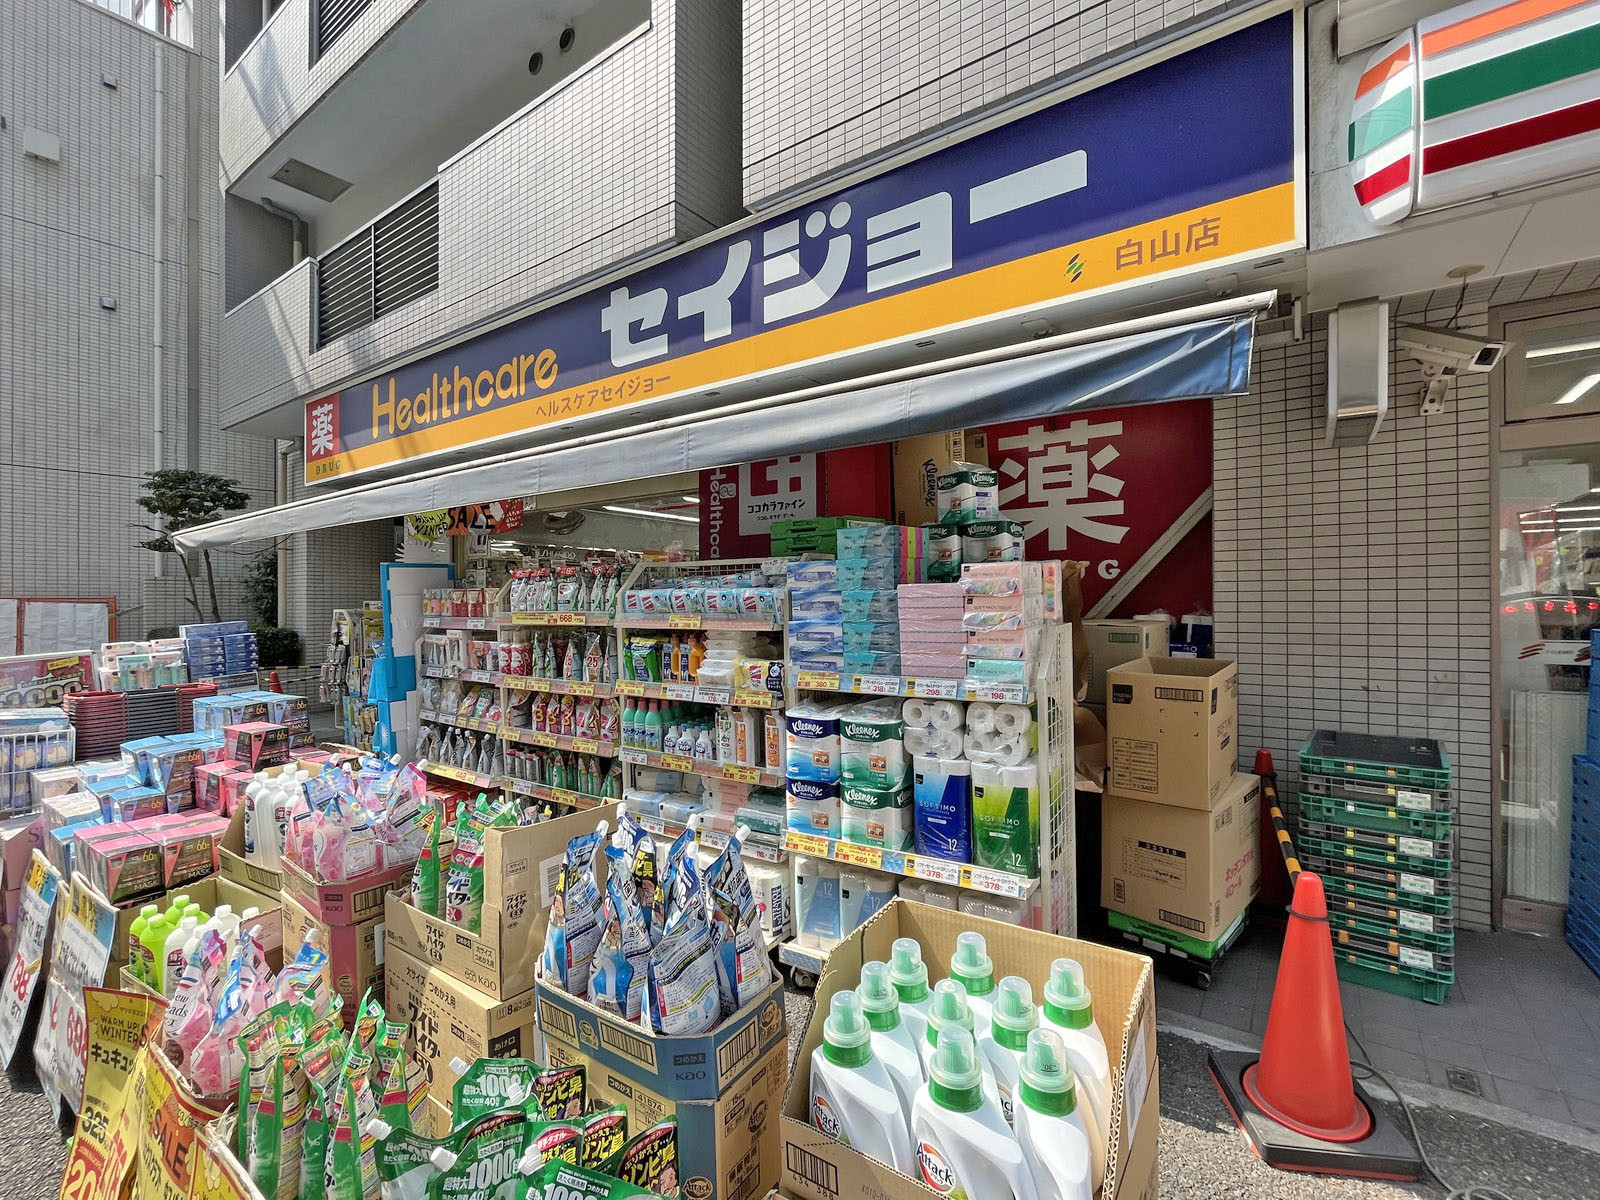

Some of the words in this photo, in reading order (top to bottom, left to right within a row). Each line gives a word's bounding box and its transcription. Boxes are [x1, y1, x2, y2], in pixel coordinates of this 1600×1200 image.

[1115, 217, 1221, 270] 白山店
[601, 149, 1088, 367] セイジョー
[372, 348, 559, 439] Healthcare
[536, 375, 671, 417] ヘルスケアセイジョー
[311, 404, 335, 457] 薬
[315, 459, 341, 475] DRUG
[923, 459, 938, 507] Kleenex
[971, 472, 995, 484] Kleenex
[998, 420, 1130, 551] 薬
[710, 468, 727, 559] Healthca
[747, 499, 806, 514] ココカラファイン
[448, 504, 496, 530] SALE
[792, 720, 823, 734] Kleenex
[845, 724, 880, 739] Kleenex
[791, 782, 823, 797] Kleenex
[844, 789, 878, 805] Kleenex
[948, 839, 957, 851] 12
[1012, 853, 1022, 867] 12
[188, 869, 212, 878] MASK
[926, 870, 941, 878] 378
[134, 881, 158, 891] MASK
[823, 882, 833, 896] 12
[984, 881, 1000, 890] 378
[447, 892, 471, 905] イター
[507, 893, 526, 904] ワイド
[871, 897, 880, 910] 12
[426, 924, 445, 939] ワイド
[476, 946, 493, 957] 大サイズ
[475, 955, 495, 969] つめかえ用
[406, 967, 426, 985] 大サイズ
[429, 982, 457, 1010] つめかえ用
[478, 976, 497, 992] kao
[175, 993, 189, 1002] ew
[169, 1004, 189, 1018] ads
[100, 1014, 124, 1030] WARM
[127, 1018, 141, 1031] UP!
[408, 1002, 439, 1037] ワイド
[100, 1028, 139, 1044] WINTER
[91, 1042, 136, 1075] キュキュッ
[675, 1055, 705, 1064] つめかえ
[675, 1070, 706, 1081] kao
[813, 1095, 839, 1133] Attack
[82, 1106, 109, 1146] 325
[153, 1108, 189, 1180] SALE
[916, 1142, 953, 1186] Attack
[683, 1181, 711, 1193] Attack
